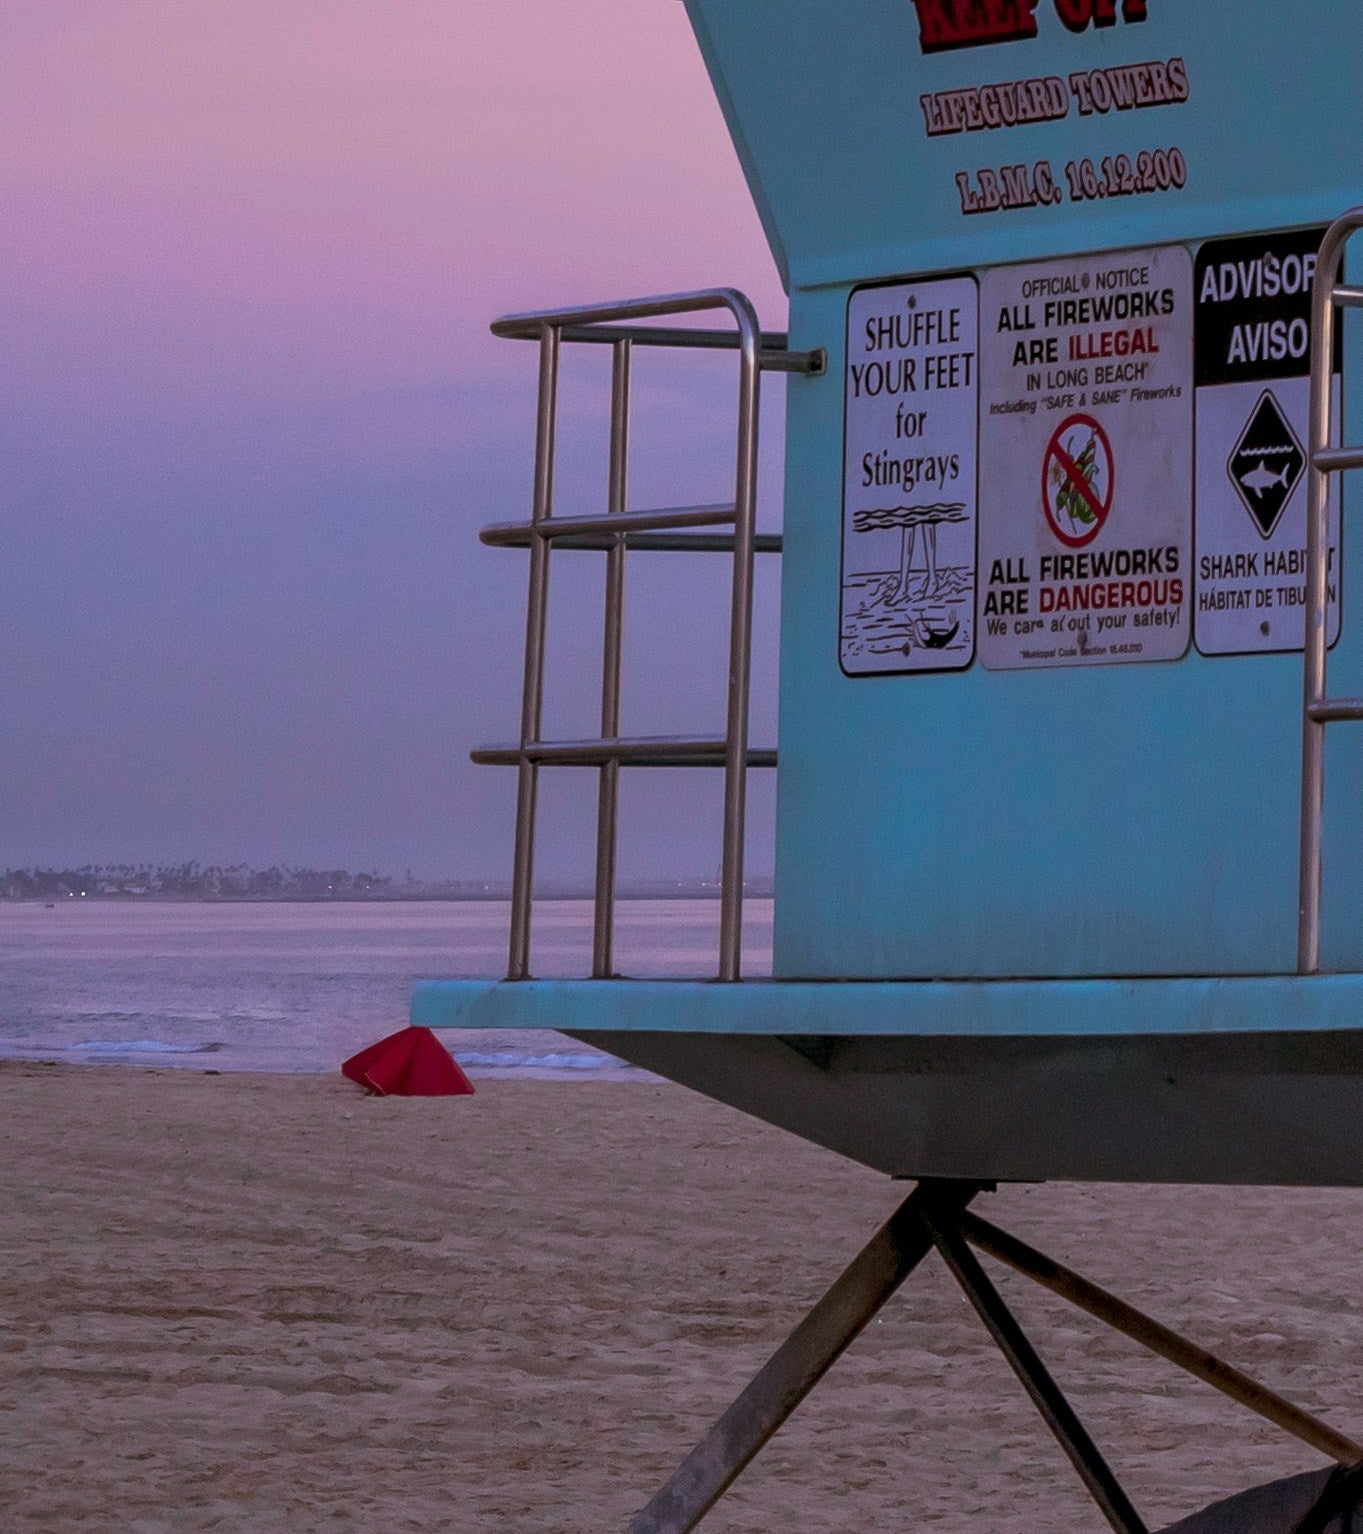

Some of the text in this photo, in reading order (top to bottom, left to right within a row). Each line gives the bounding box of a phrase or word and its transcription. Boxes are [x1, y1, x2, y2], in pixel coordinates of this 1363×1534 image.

[919, 57, 1190, 137] LIFEGUARD TOWERS
[955, 147, 1187, 216] L.B.M.C. 16.12.200
[1021, 267, 1149, 299] OFFICIAL NOTICE
[1200, 252, 1319, 303] ADVISOR
[865, 308, 961, 352] SHUFFLE
[997, 288, 1175, 333] ALL FIREWORKS
[1012, 326, 1160, 367] ARE ILLEGAL
[1226, 317, 1309, 365] AVISO
[851, 352, 975, 398] YOUR FEET
[1026, 373, 1041, 392] IN
[1047, 368, 1089, 390] LONG
[895, 401, 928, 439] for
[989, 399, 1037, 415] Including
[1130, 385, 1182, 401] Fireworks
[861, 448, 960, 494] Stingrays
[989, 545, 1180, 586] ALL FIREWORKS
[1199, 546, 1336, 581] SHARK HABIT
[982, 578, 1184, 617] ARE DANGEROUS
[1255, 587, 1274, 608] DE
[986, 618, 1008, 636] We
[1097, 614, 1127, 634] your
[1133, 606, 1181, 630] safety!
